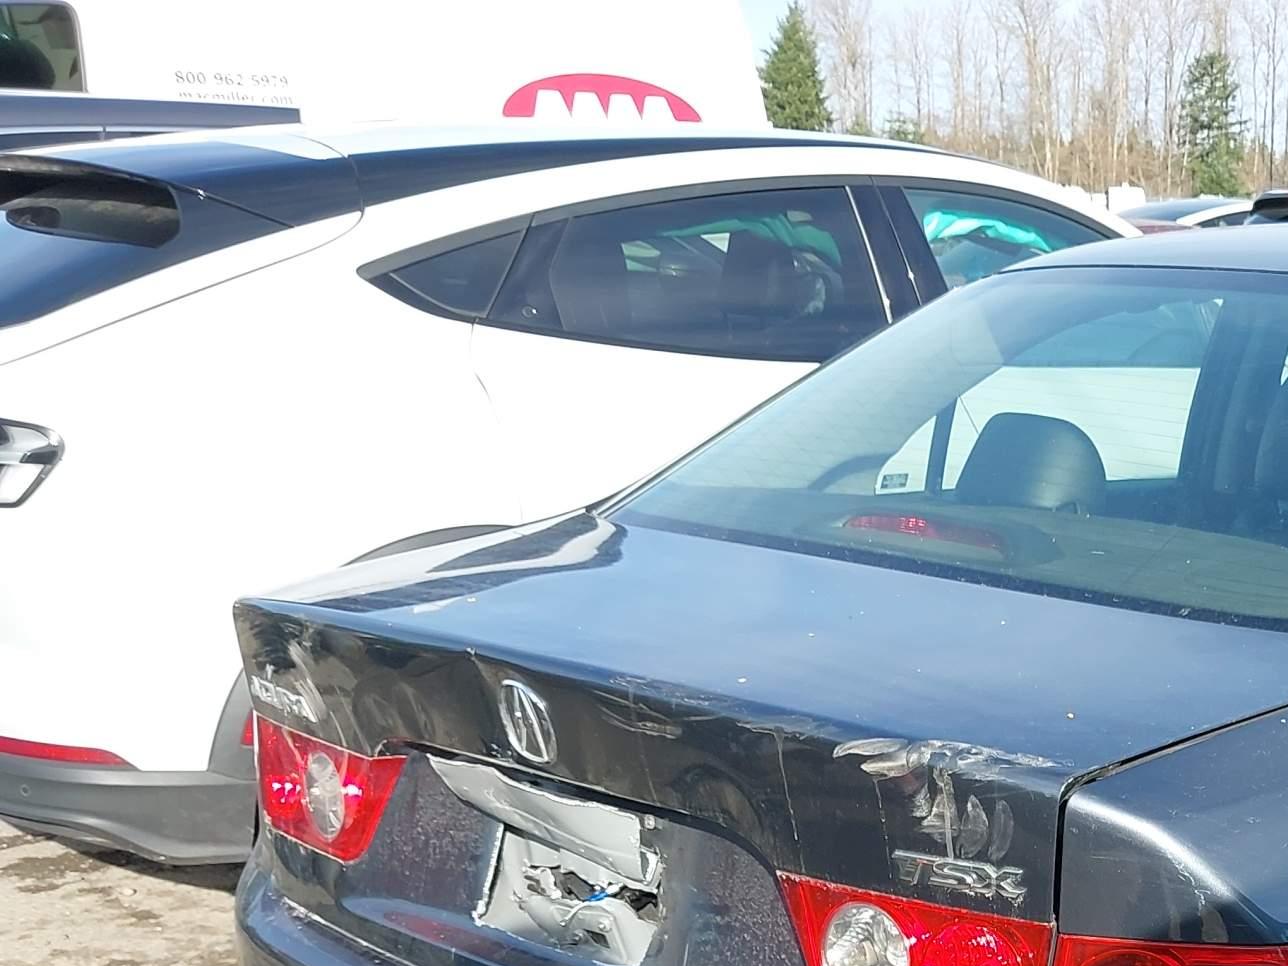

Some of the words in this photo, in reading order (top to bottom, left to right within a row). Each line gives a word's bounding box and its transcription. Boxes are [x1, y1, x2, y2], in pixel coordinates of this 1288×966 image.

[175, 70, 206, 84] 800
[214, 72, 243, 86] 962
[179, 91, 293, 105] macmillercom
[891, 849, 1027, 899] TSX
